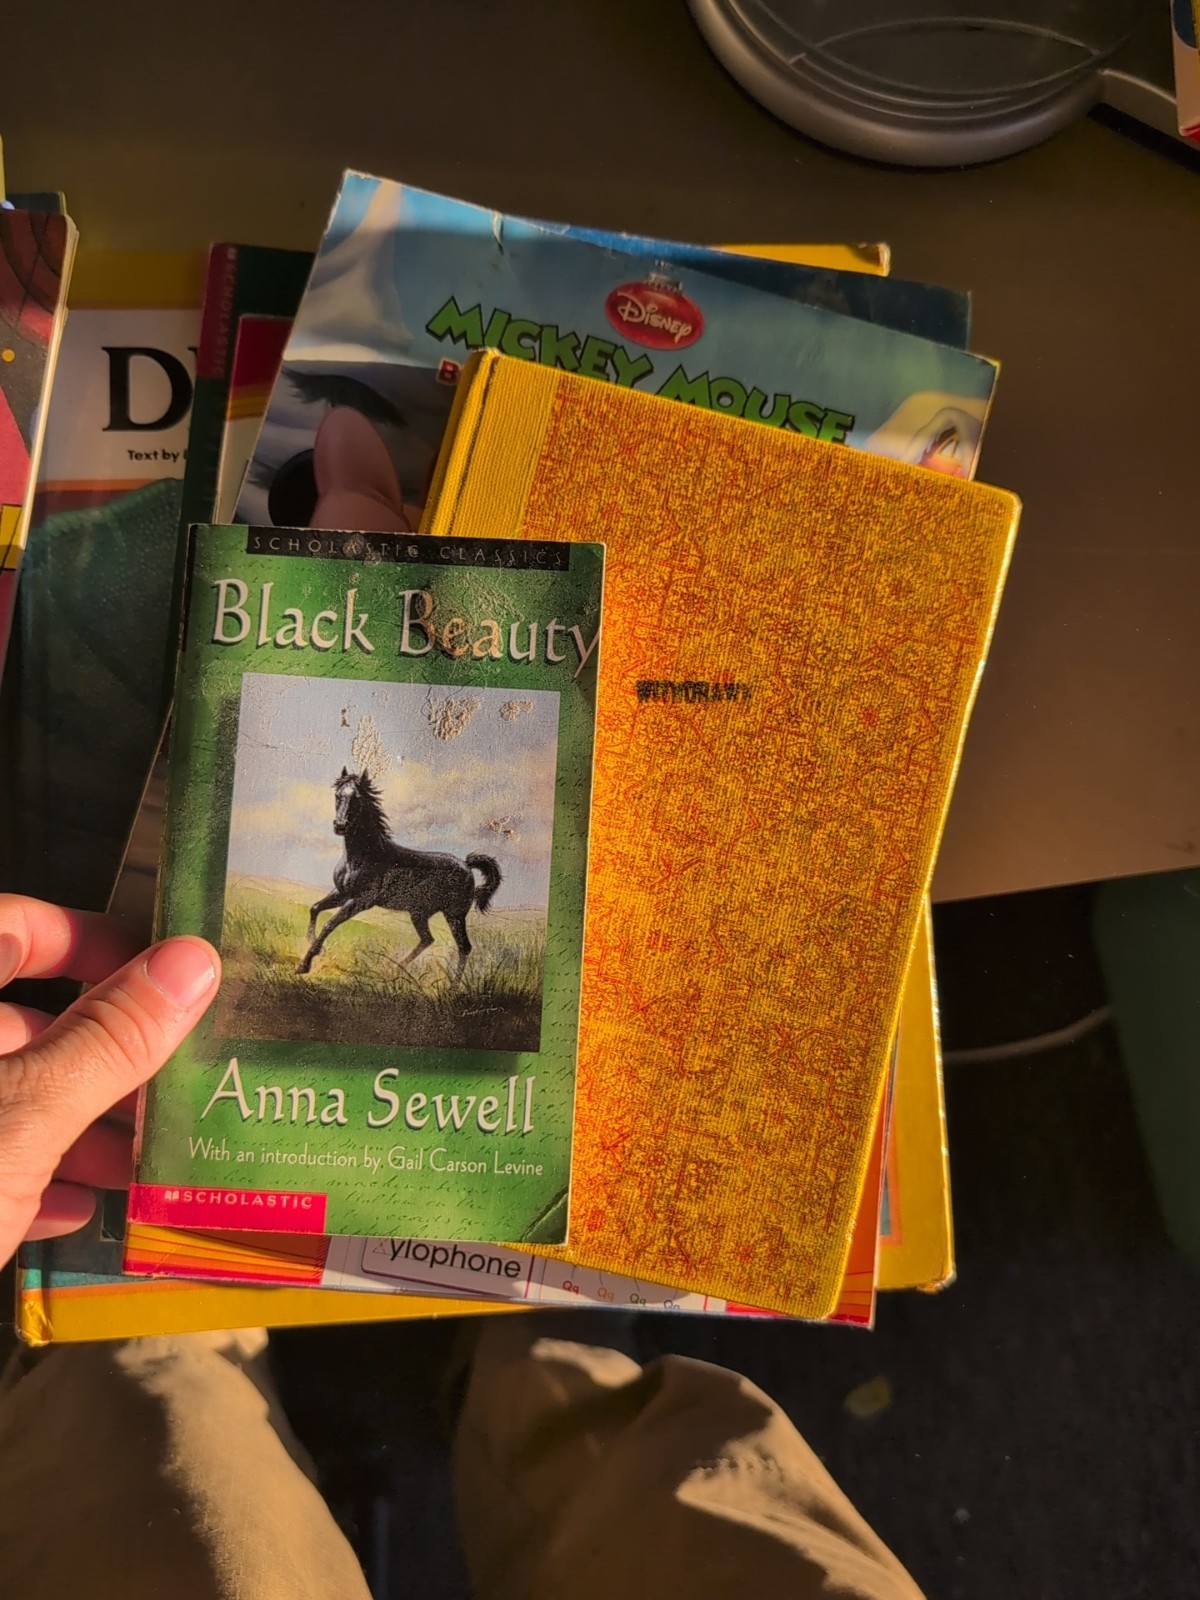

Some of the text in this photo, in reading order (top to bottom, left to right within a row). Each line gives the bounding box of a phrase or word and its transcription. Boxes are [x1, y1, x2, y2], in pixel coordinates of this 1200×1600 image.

[102, 345, 199, 432] D
[425, 296, 855, 444] MICKEY MOUSE
[127, 448, 180, 463] Text by
[253, 536, 562, 565] SCHOLASTIC CLASSICS
[212, 578, 601, 680] Black Beauty
[200, 1057, 536, 1135] Anna Sewell
[188, 1136, 544, 1177] With an introduction by Gail Carson Levine
[183, 1190, 313, 1210] SCHOLASTIC
[562, 1280, 580, 1295] Qq
[597, 1287, 615, 1302] Qq
[629, 1293, 647, 1307] Qq
